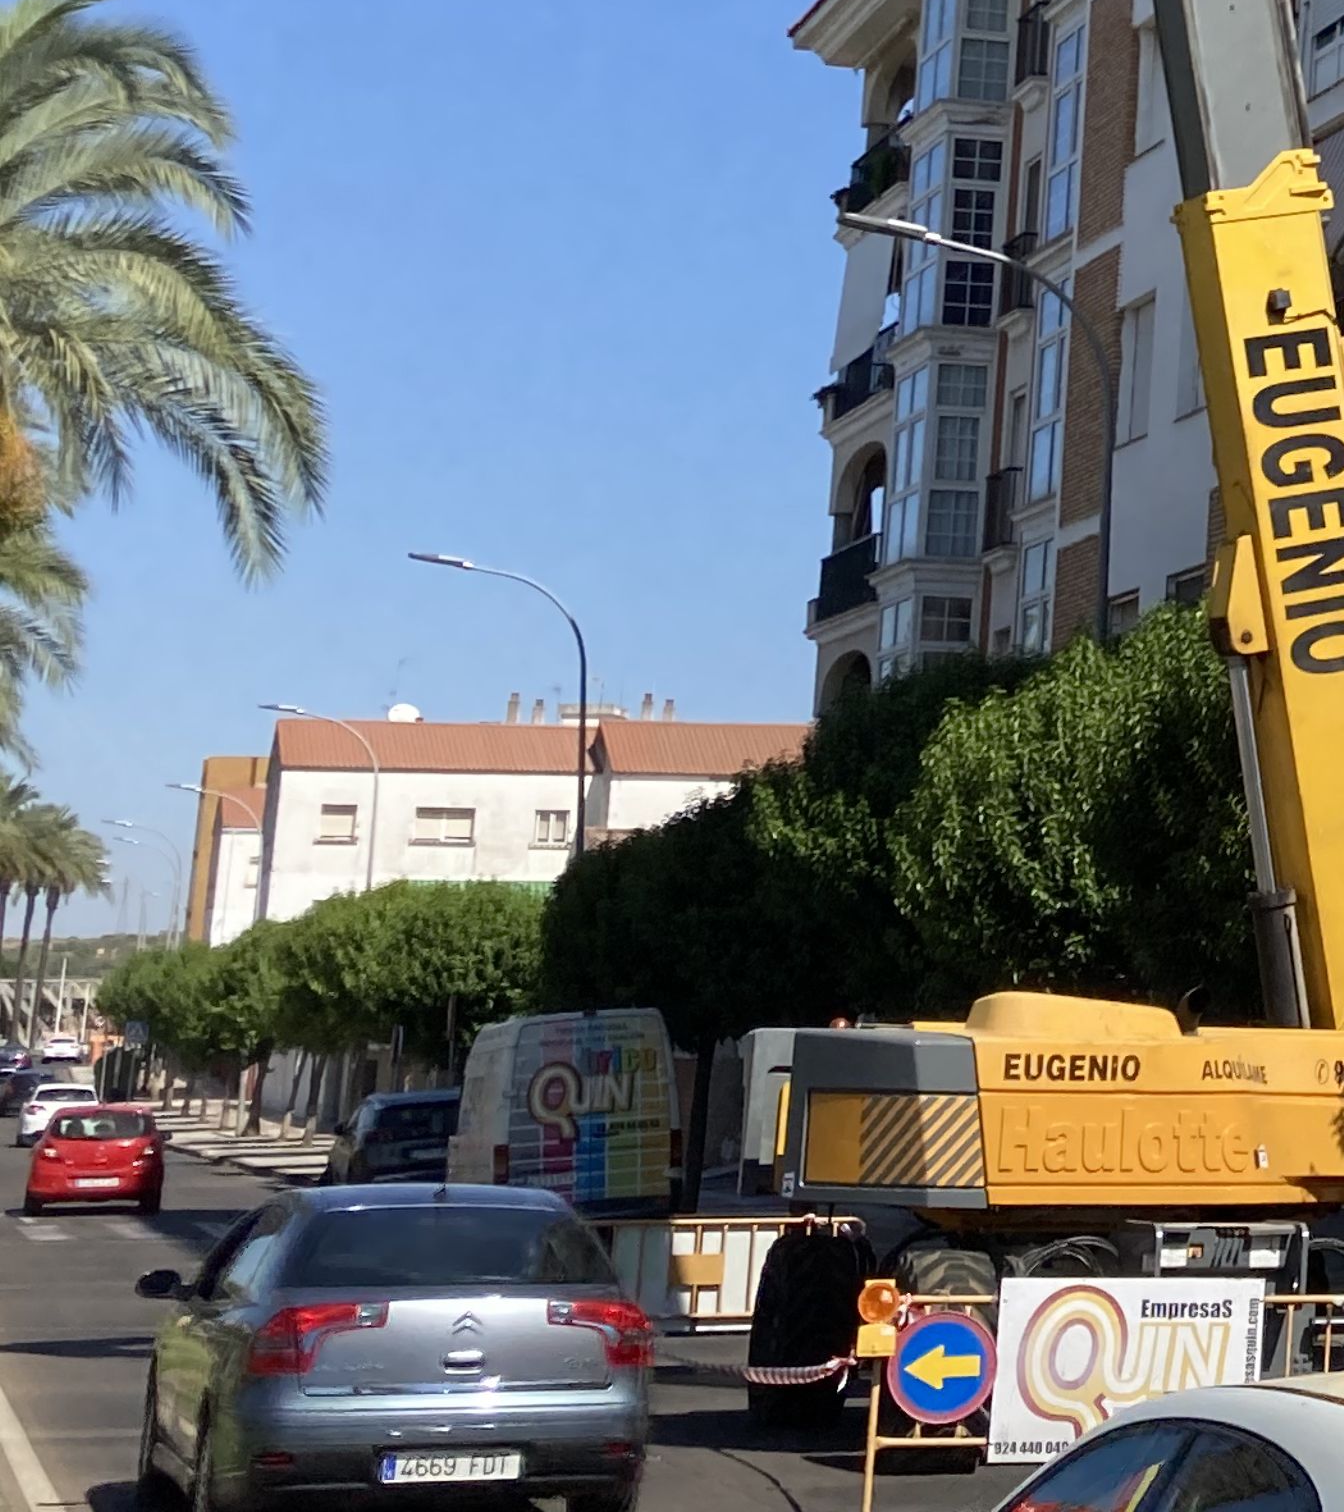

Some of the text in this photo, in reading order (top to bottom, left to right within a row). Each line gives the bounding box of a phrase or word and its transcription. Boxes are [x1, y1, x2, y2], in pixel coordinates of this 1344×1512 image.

[1003, 1053, 1141, 1082] EUGENIO
[997, 1104, 1250, 1174] Haulotte
[1141, 1299, 1233, 1320] EmpresaS
[1016, 1284, 1231, 1439] QUIN
[994, 1441, 1017, 1455] 924
[1019, 1440, 1042, 1455] 440
[400, 1453, 507, 1478] 4669 FDT
